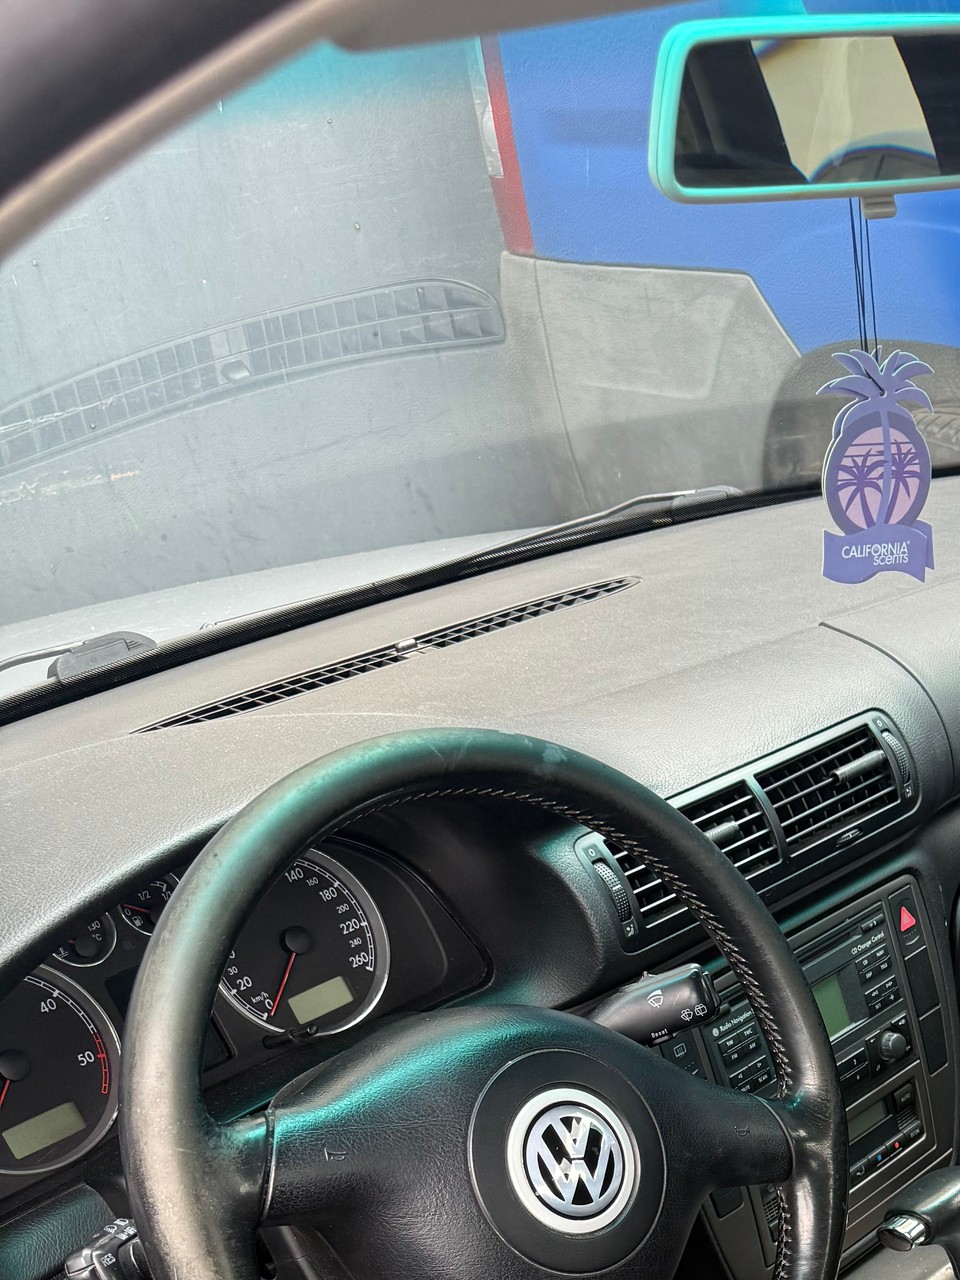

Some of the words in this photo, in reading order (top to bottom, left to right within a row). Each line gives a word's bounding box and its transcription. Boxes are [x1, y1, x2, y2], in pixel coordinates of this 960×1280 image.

[841, 541, 909, 559] CALIFORNIA
[873, 553, 909, 566] scents
[284, 867, 304, 883] 140
[305, 877, 319, 887] 160
[138, 890, 151, 901] 1/2
[319, 887, 338, 902] 180
[336, 903, 350, 914] 200
[339, 918, 360, 935] 220
[349, 937, 362, 948] 240
[349, 952, 369, 968] 260
[227, 966, 238, 976] 30
[236, 976, 253, 991] 20
[250, 991, 270, 1004] km/h
[265, 999, 273, 1010] 0
[40, 998, 57, 1014] 40
[77, 1050, 95, 1067] 50
[100, 1252, 116, 1267] RES
